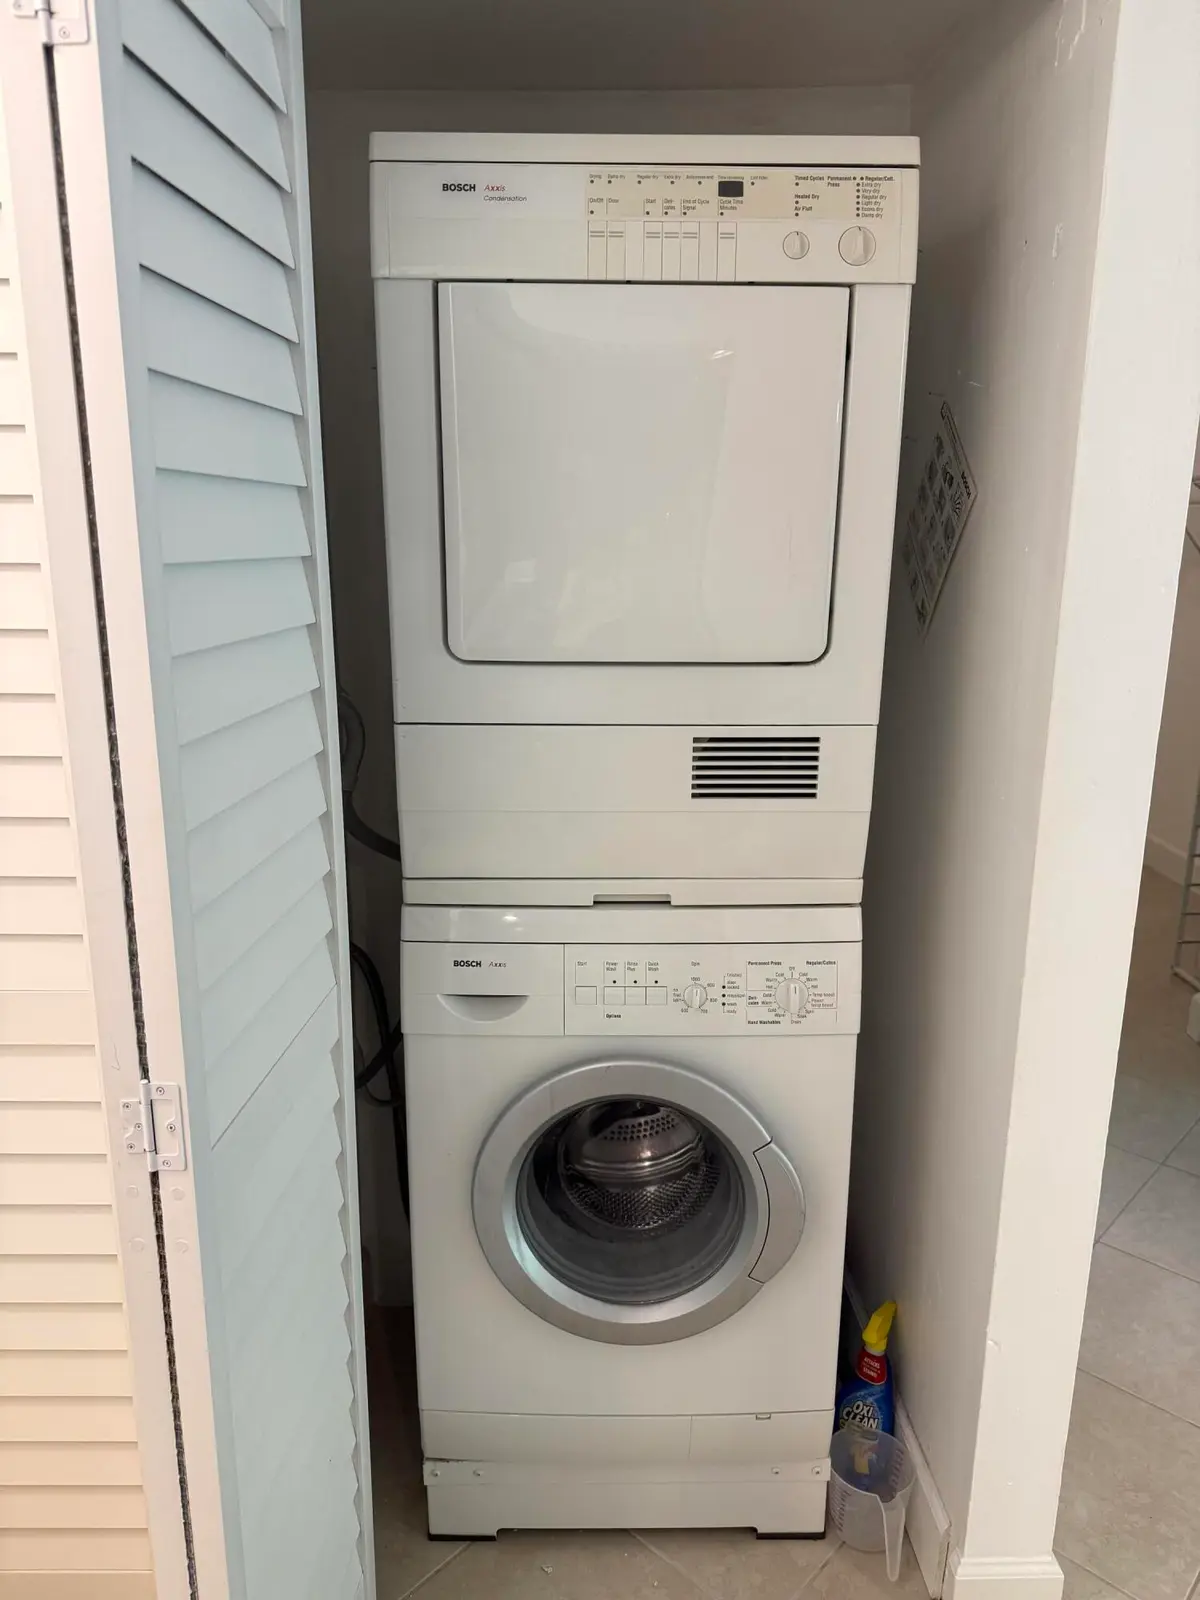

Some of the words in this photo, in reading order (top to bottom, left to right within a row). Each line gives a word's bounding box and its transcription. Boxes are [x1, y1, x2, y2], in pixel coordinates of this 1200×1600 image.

[442, 184, 476, 192] BOSCH
[842, 1407, 878, 1429] CLEAN
[853, 1400, 874, 1418] OXI
